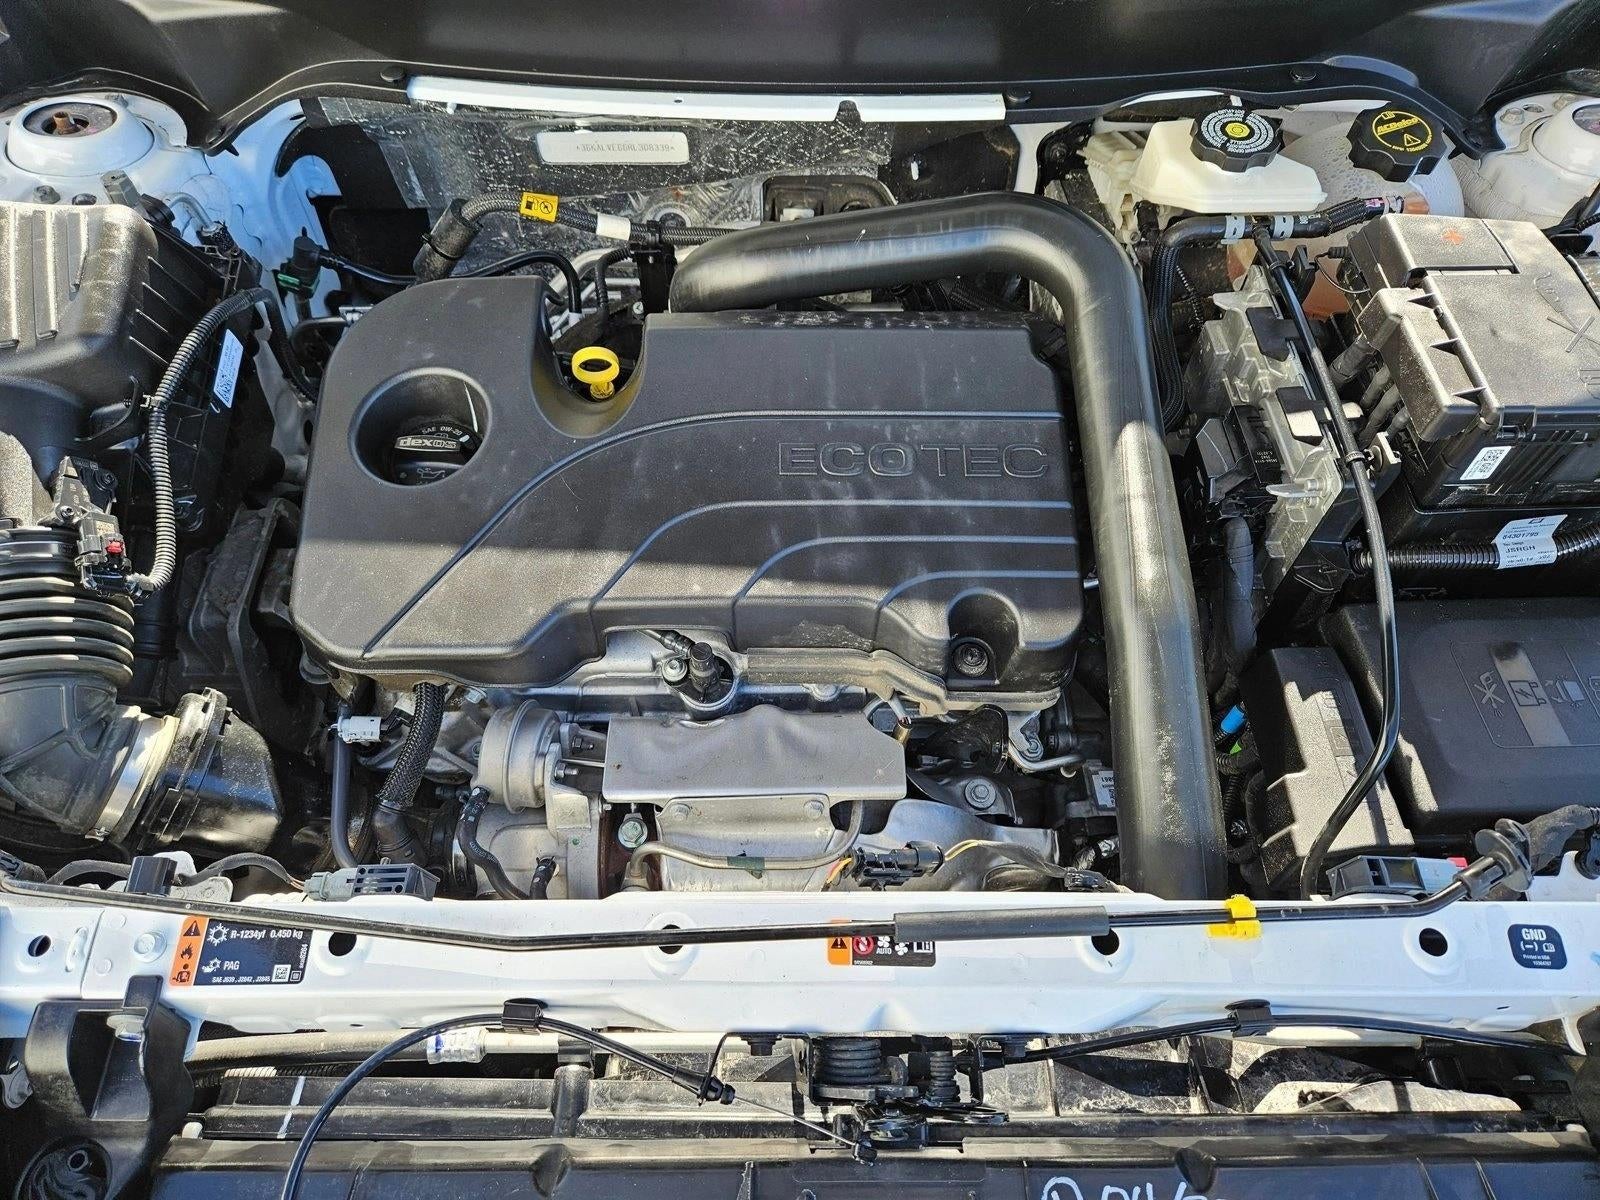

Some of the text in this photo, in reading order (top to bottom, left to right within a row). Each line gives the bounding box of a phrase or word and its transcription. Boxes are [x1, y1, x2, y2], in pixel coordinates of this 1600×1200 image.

[422, 426, 437, 435] SAE
[399, 437, 457, 449] dexos
[778, 441, 1049, 478] ECOTEC
[230, 929, 304, 940] R-1234yf 0.450 kg
[1521, 928, 1547, 941] GND
[876, 947, 892, 955] AUTO
[223, 960, 240, 971] PAG
